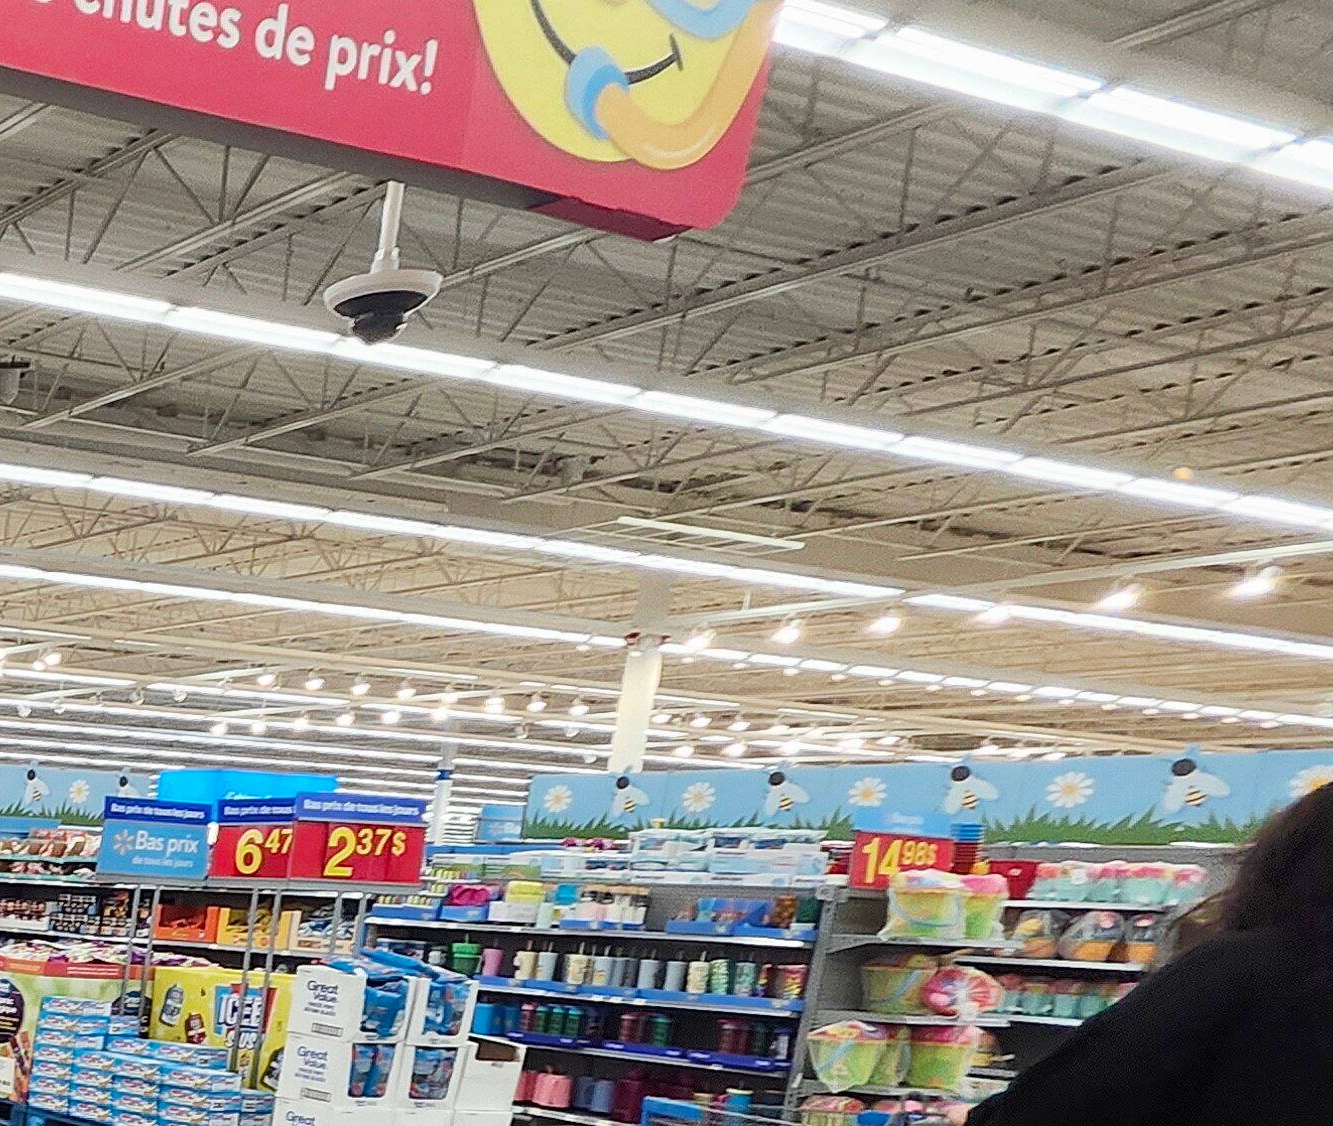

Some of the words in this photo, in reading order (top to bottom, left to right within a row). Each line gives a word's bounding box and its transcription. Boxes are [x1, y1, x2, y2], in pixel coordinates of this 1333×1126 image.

[255, 4, 316, 65] de
[324, 30, 439, 96] prix!
[135, 830, 164, 851] Bas
[166, 834, 199, 858] prix
[307, 980, 339, 995] Great
[313, 992, 337, 1004] Value
[297, 1046, 328, 1061] Great
[303, 1057, 327, 1070] Value
[285, 1111, 315, 1126] Great
